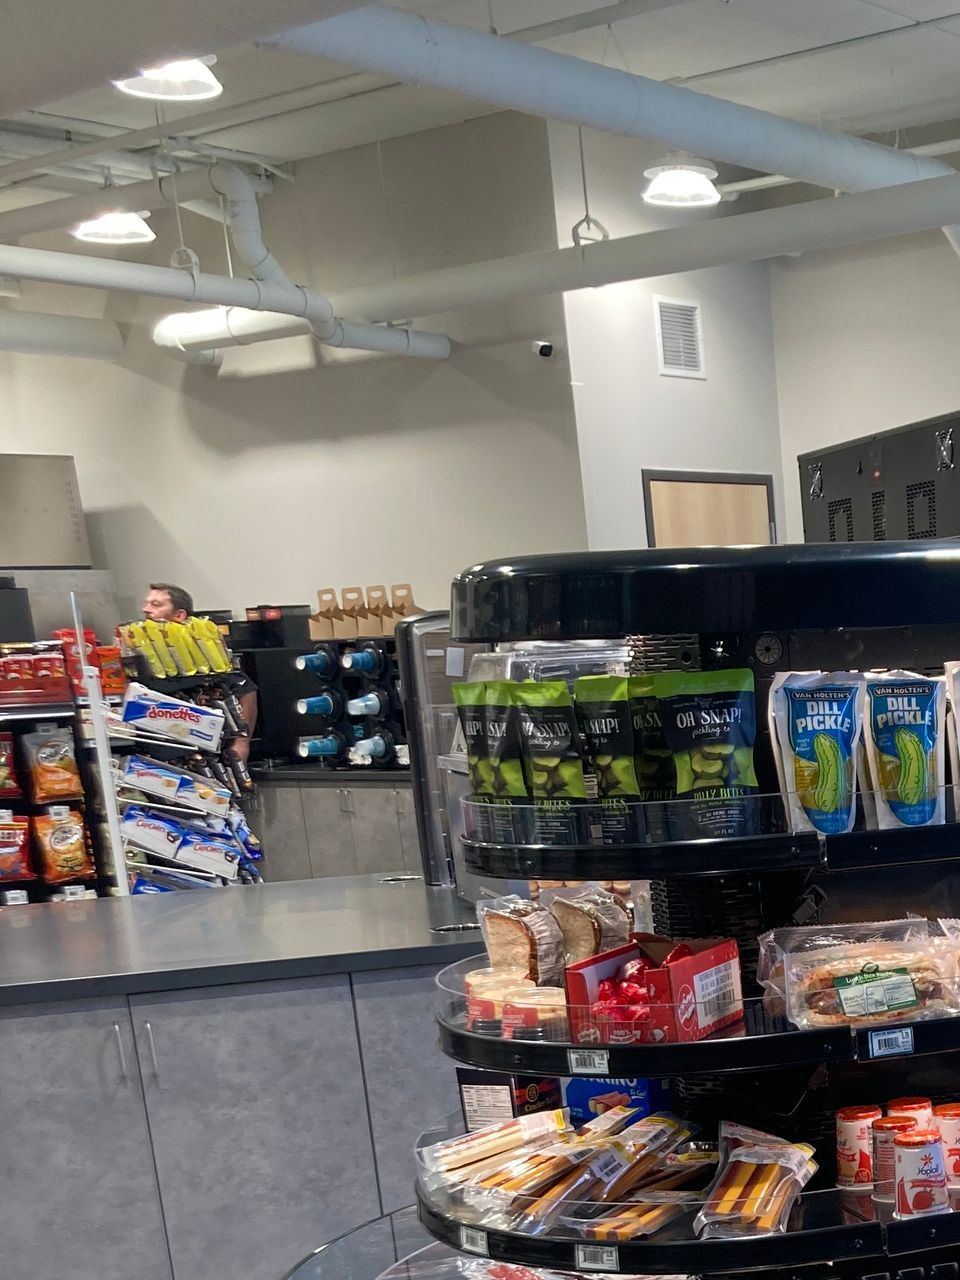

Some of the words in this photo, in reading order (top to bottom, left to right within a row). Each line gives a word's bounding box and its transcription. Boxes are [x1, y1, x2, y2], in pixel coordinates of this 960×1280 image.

[806, 701, 841, 716] DILL
[887, 697, 920, 711] DILL
[147, 705, 202, 726] donettes
[676, 711, 696, 729] OH
[701, 707, 743, 726] SNAP!
[877, 711, 931, 728] PICKLE
[692, 724, 721, 739] pickling
[796, 715, 851, 733] PICKLE
[694, 789, 716, 801] DILLY
[720, 788, 744, 799] BITES
